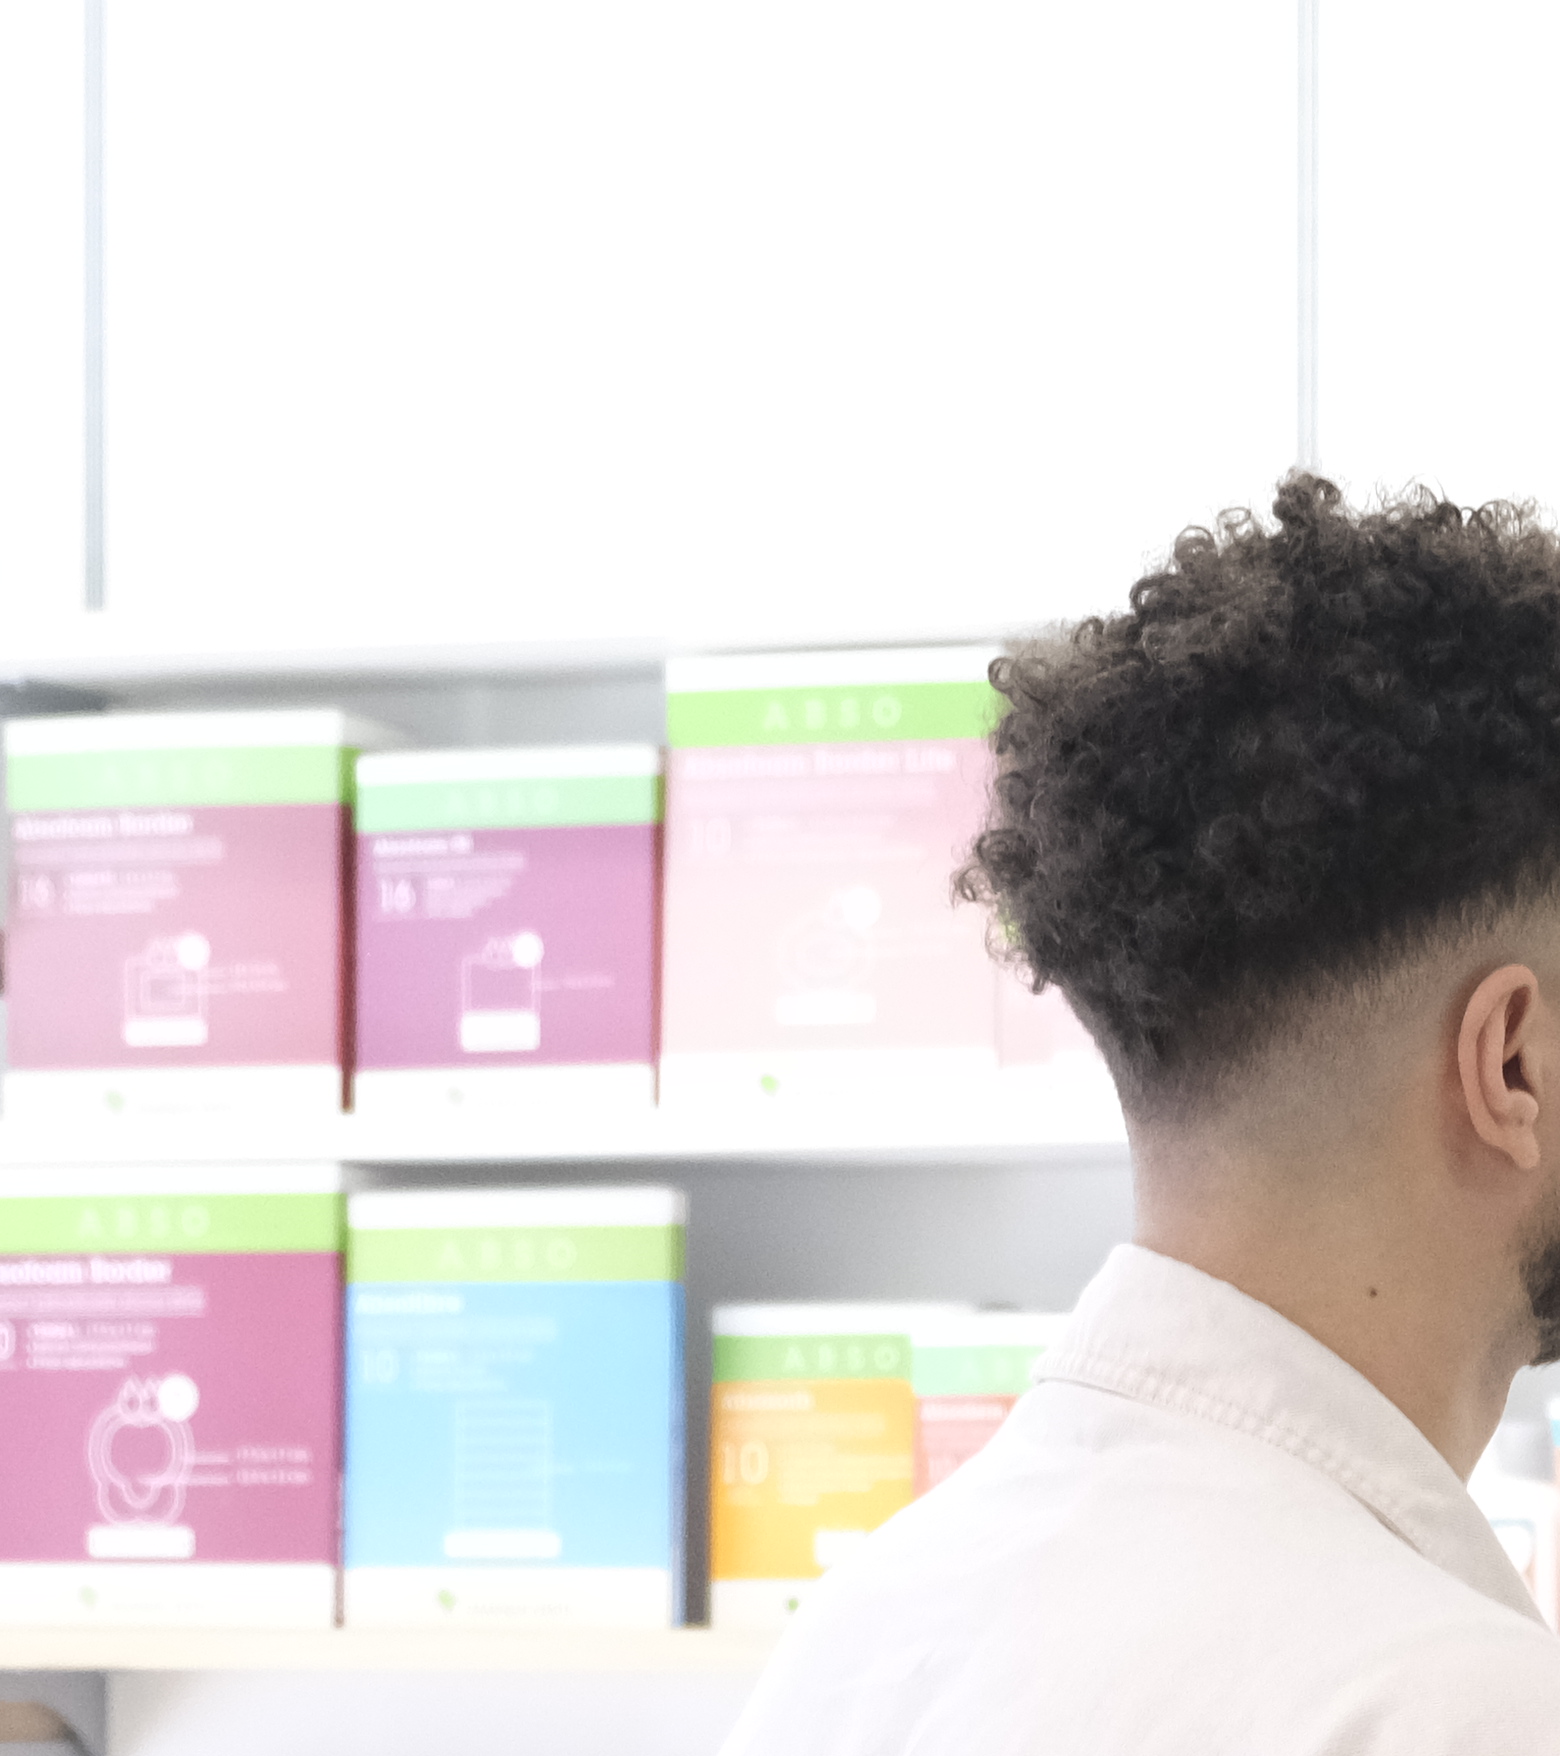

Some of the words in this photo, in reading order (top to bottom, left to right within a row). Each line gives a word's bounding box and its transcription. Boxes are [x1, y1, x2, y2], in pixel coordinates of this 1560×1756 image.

[761, 694, 903, 732] ABSO
[77, 1204, 210, 1239] ABSO
[437, 1237, 578, 1272] ABSO
[781, 1343, 900, 1373] ABSO
[720, 1439, 770, 1486] 10
